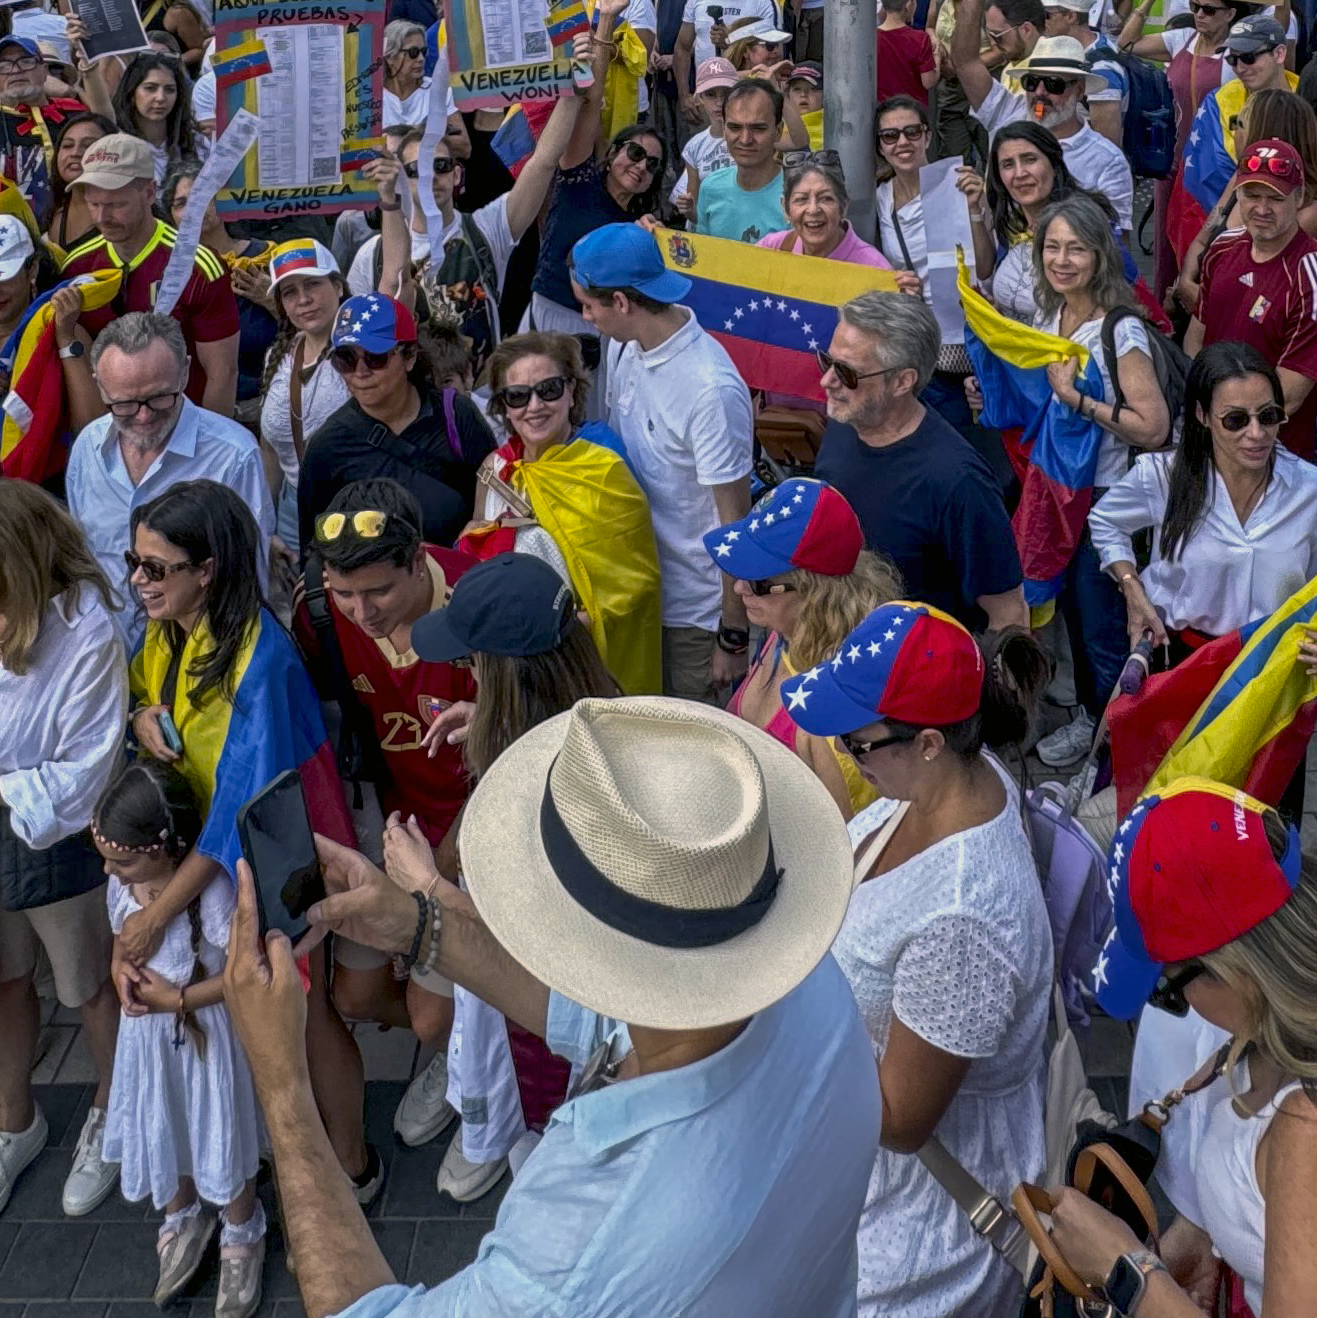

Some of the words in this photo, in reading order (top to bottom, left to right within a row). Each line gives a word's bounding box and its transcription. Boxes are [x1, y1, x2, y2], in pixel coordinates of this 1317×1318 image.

[257, 6, 350, 25] PRUEBAS
[460, 61, 586, 93] VENEZUELA
[355, 84, 373, 98] ES
[501, 84, 560, 103] WON!
[230, 184, 354, 205] VENEZUELA
[264, 199, 322, 214] GANO
